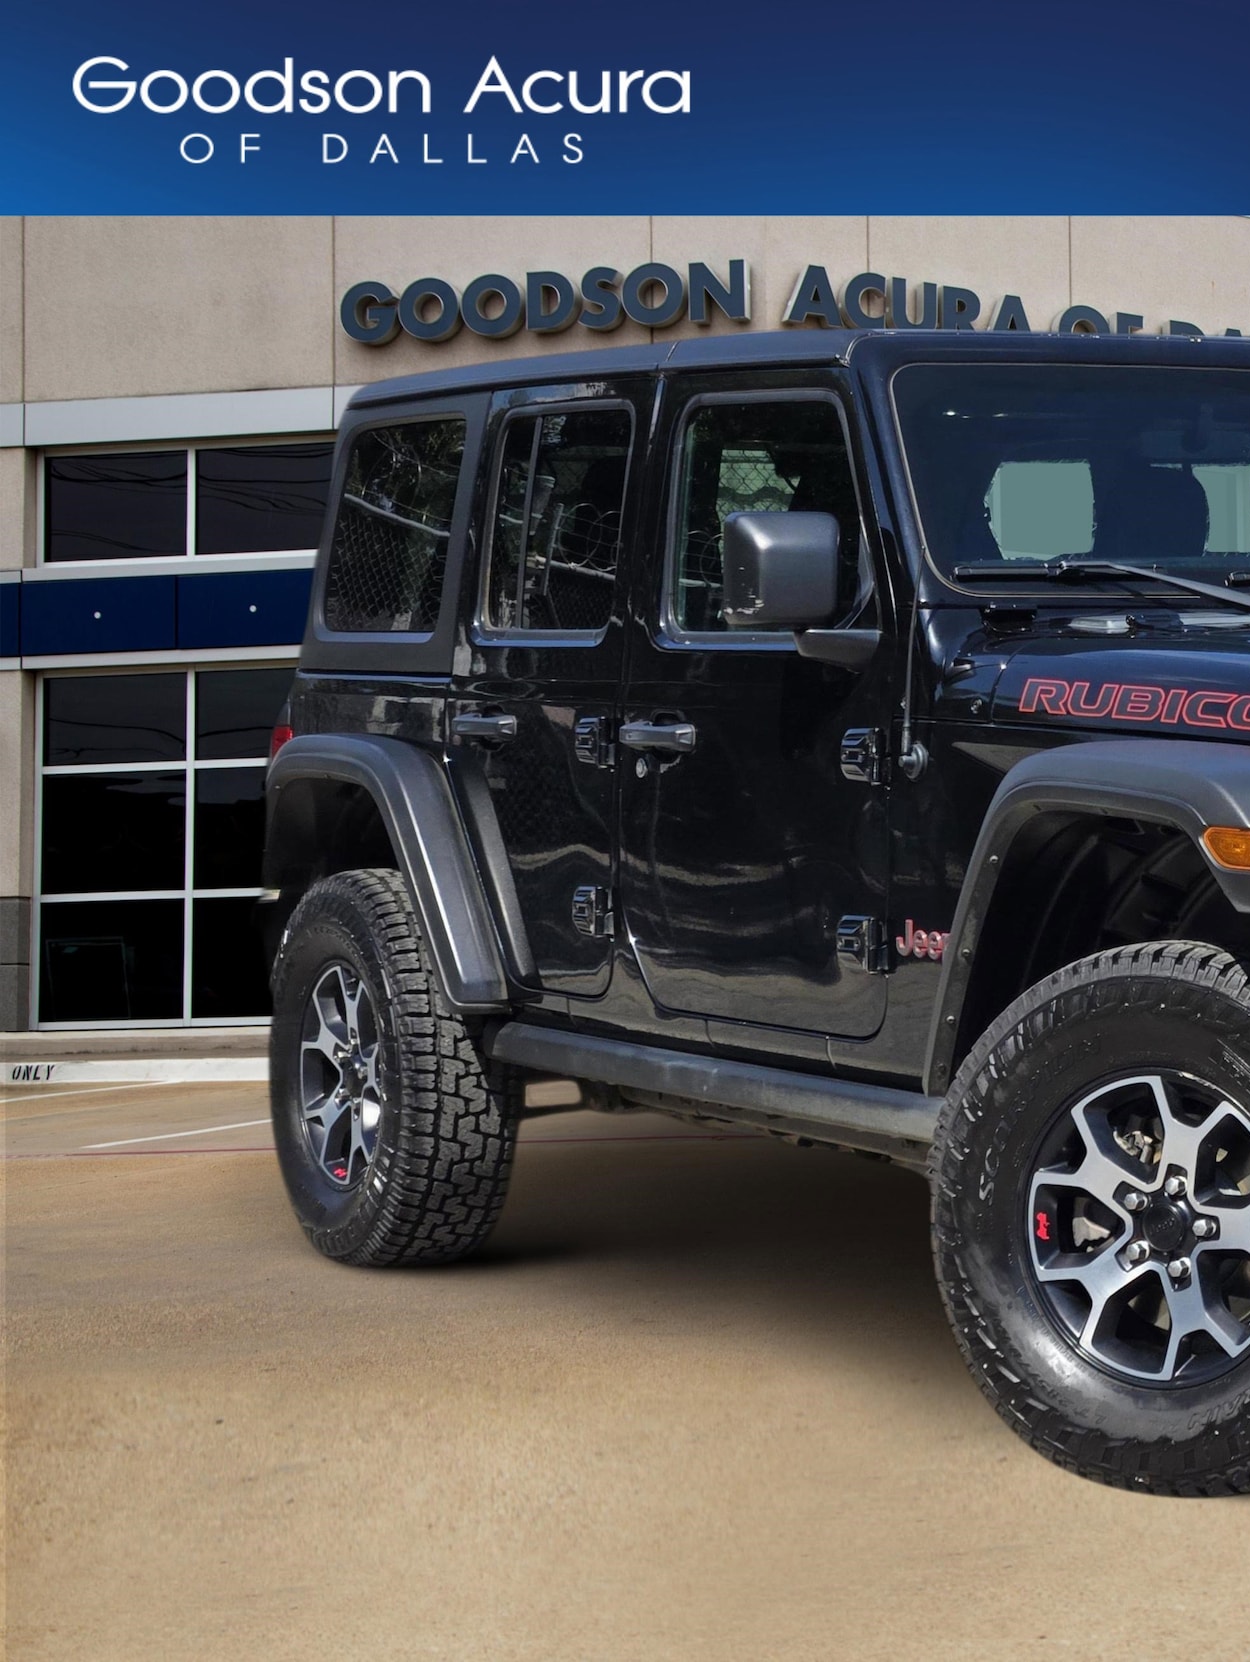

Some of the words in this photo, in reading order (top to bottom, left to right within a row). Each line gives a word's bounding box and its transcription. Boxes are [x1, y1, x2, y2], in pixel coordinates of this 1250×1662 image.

[340, 258, 751, 346] GOODSON
[783, 264, 1031, 332] ACURA
[12, 1064, 55, 1081] ONLY
